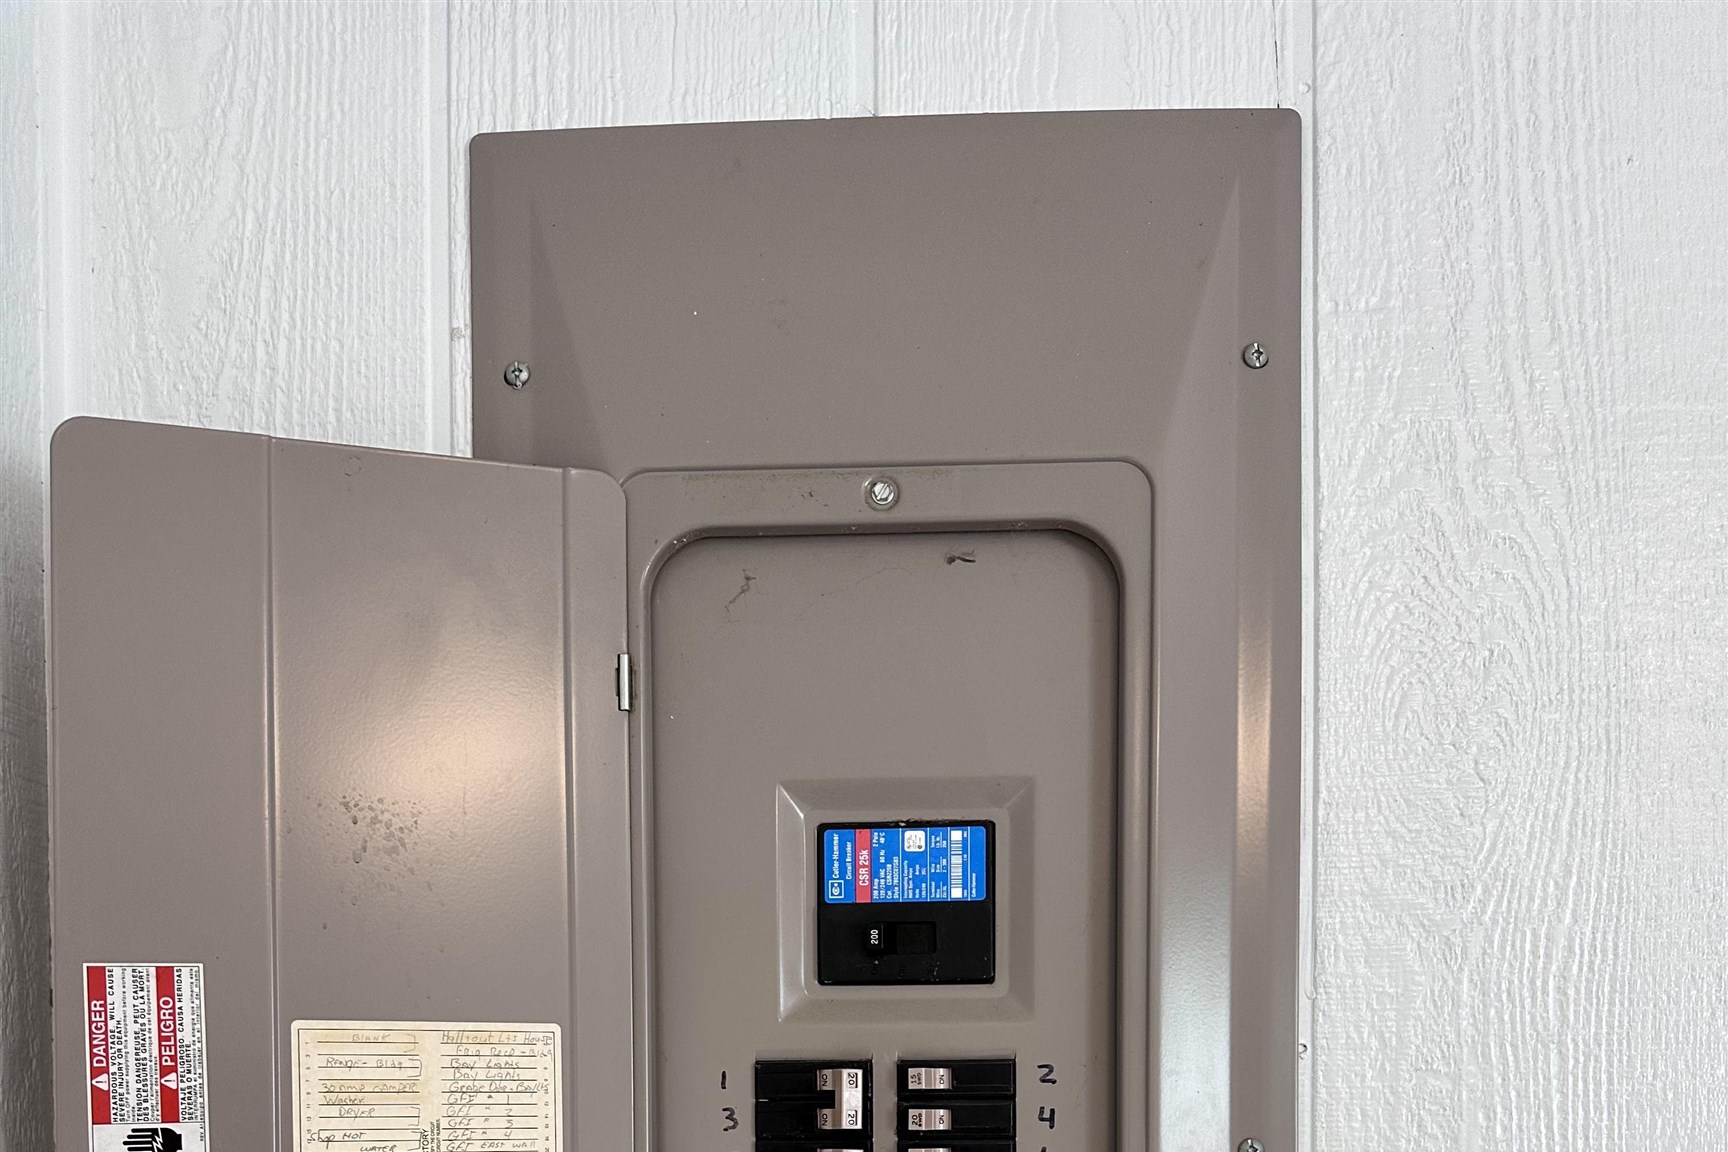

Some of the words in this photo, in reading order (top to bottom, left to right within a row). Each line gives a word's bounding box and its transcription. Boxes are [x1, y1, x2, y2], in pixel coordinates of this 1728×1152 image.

[859, 849, 869, 866] 25k
[859, 868, 869, 886] CSR
[870, 929, 879, 945] 200
[139, 995, 145, 1005] LA
[140, 1008, 146, 1020] OU
[91, 1000, 107, 1067] DANGER
[160, 997, 175, 1066] PELIGRO
[117, 1048, 123, 1059] OR
[822, 1074, 828, 1086] ON
[848, 1073, 855, 1085] 20
[939, 1075, 945, 1084] ON
[1037, 1064, 1057, 1084] 2
[111, 1072, 119, 1123] HAZARDOUS
[721, 1106, 739, 1131] 3
[822, 1113, 829, 1126] ON
[848, 1113, 855, 1125] 20
[939, 1115, 945, 1124] ON
[1037, 1106, 1056, 1130] 4
